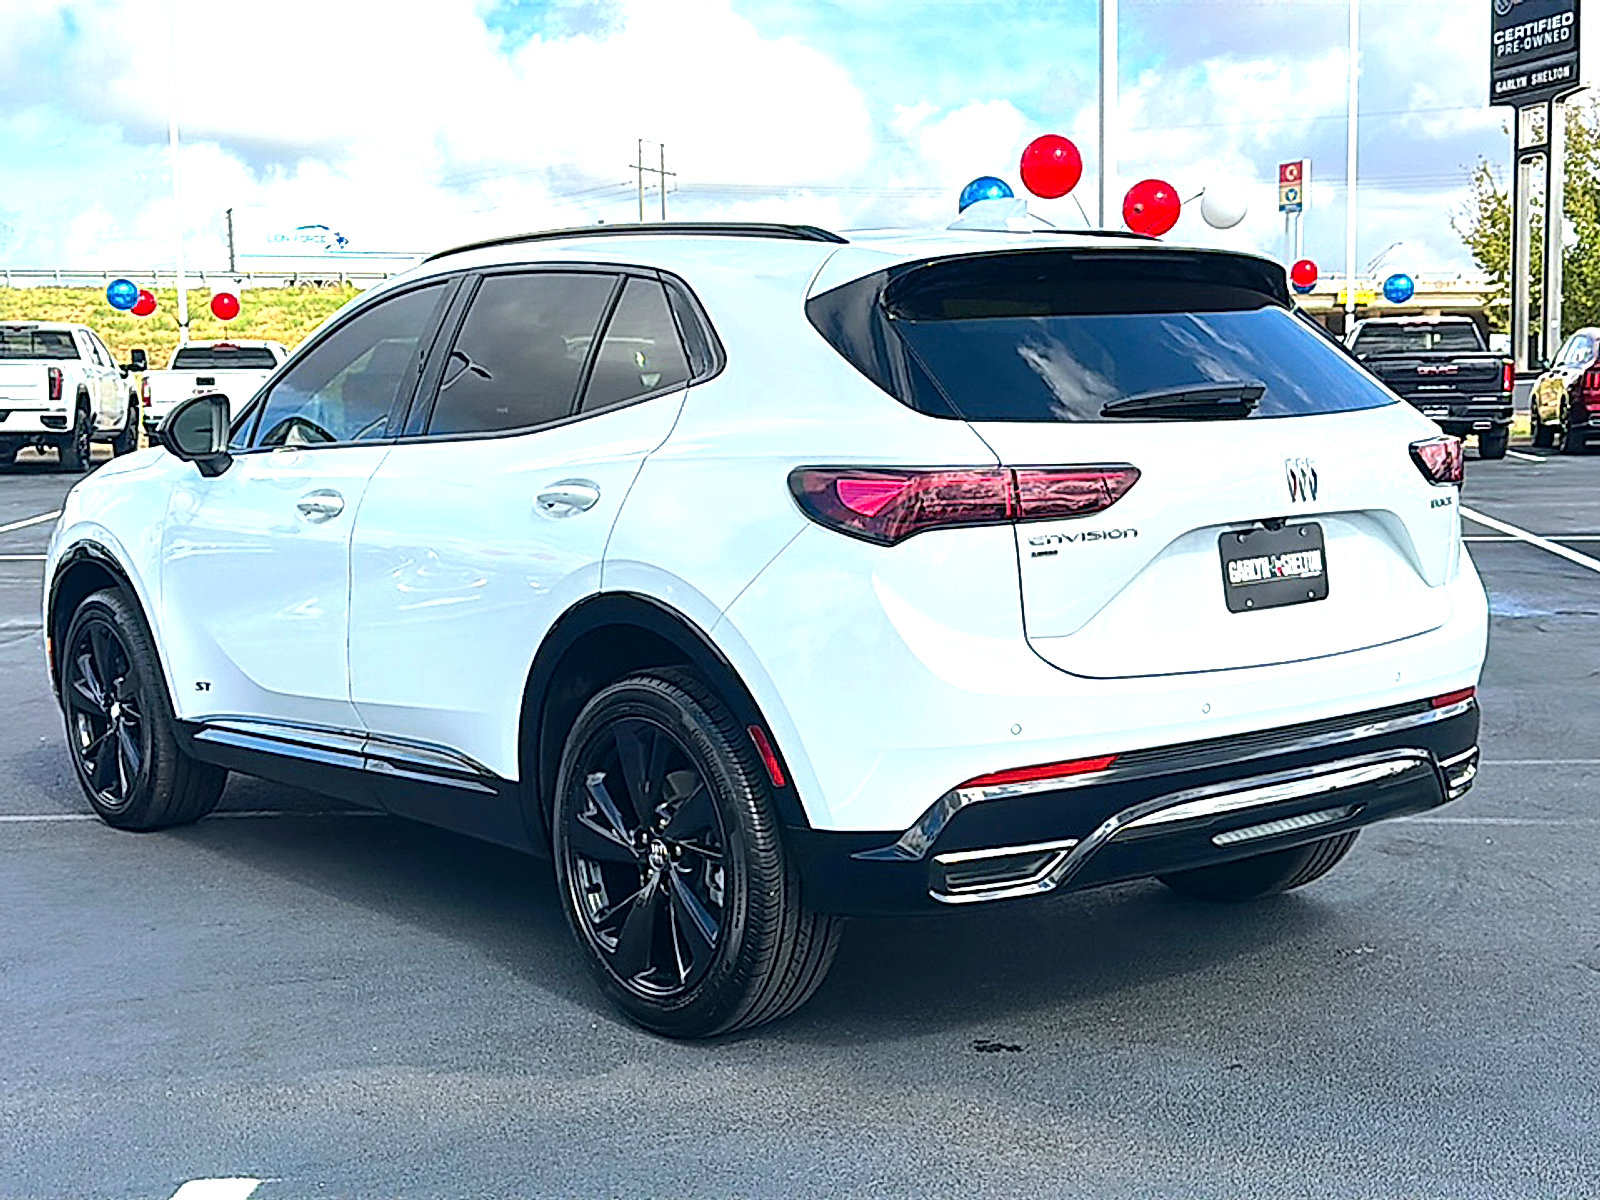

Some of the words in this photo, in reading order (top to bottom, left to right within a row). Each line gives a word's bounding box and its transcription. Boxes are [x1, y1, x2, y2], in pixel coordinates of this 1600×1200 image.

[1493, 11, 1574, 45] CERTIFIED
[1497, 27, 1570, 57] PRE-OWNED
[195, 681, 211, 691] ST
